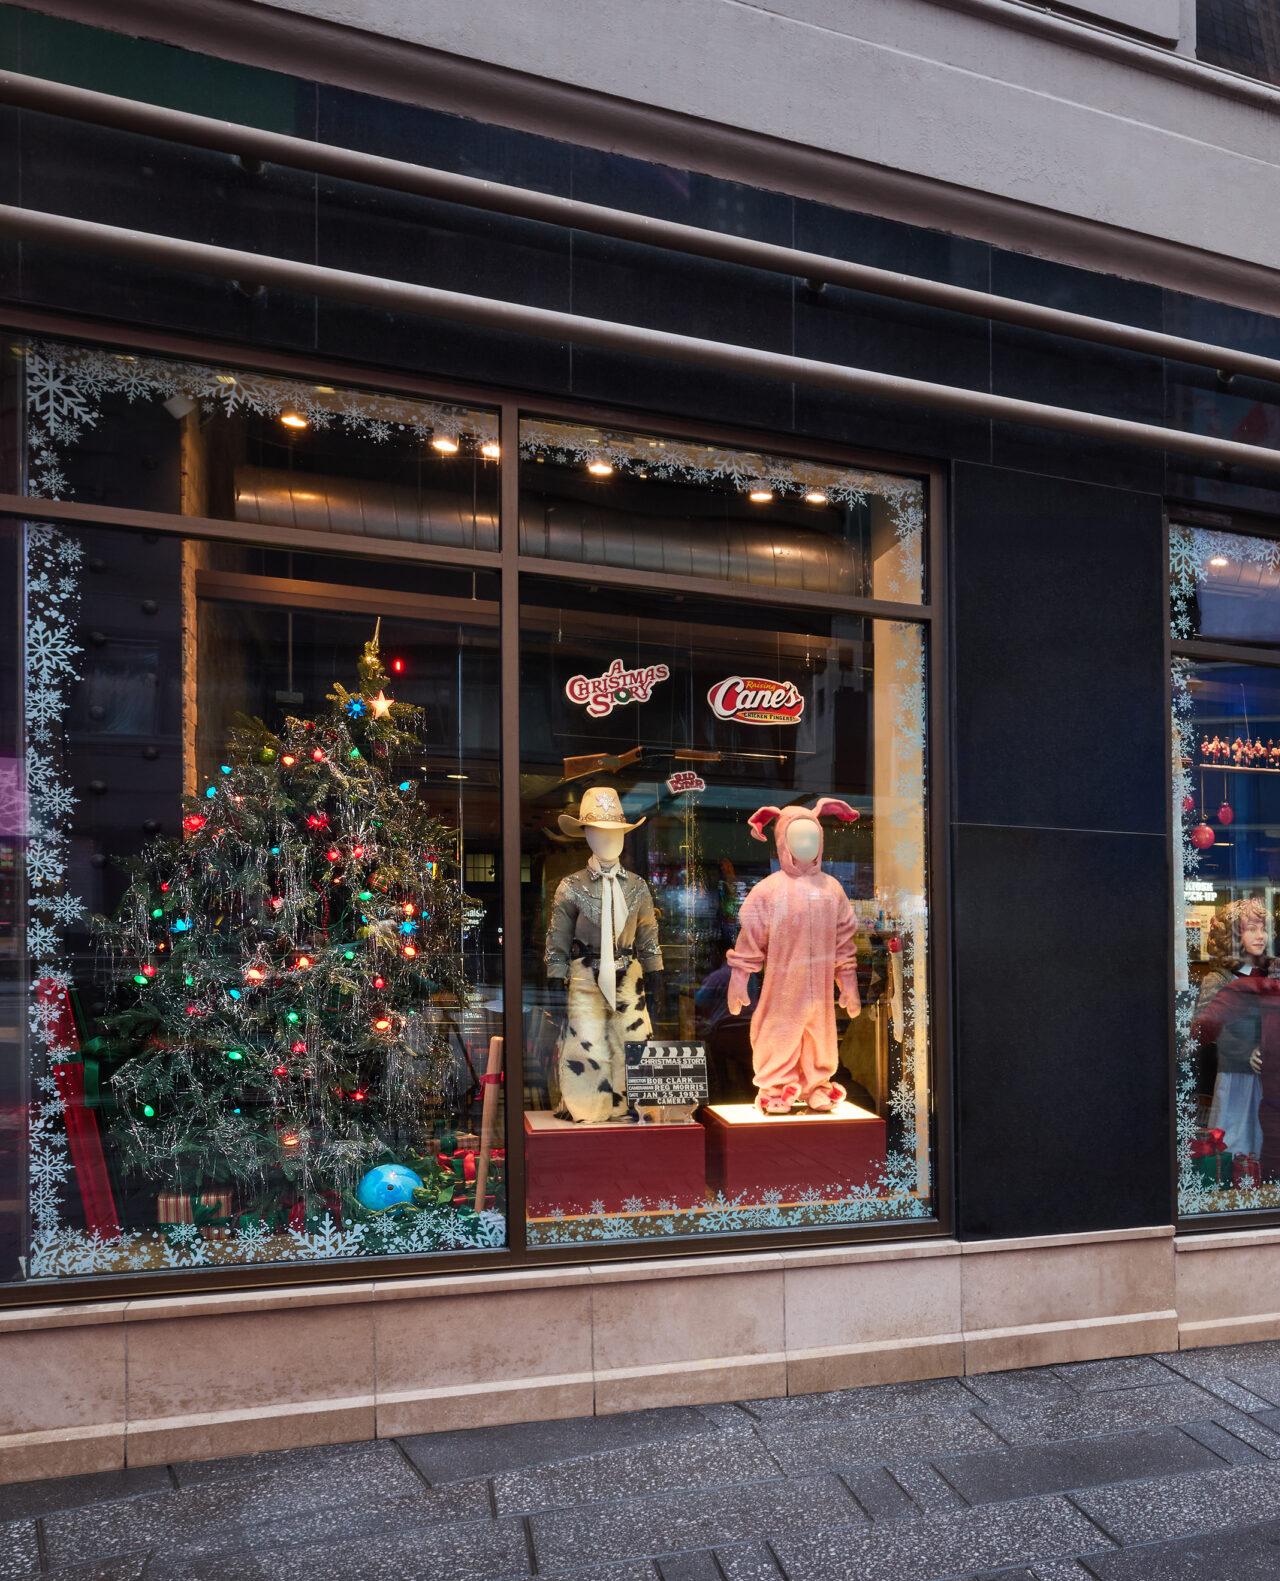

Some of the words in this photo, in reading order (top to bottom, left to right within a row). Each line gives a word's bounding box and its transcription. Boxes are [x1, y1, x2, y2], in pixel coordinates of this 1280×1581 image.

[606, 660, 623, 677] A
[568, 665, 669, 702] CHRISTMAS
[745, 680, 777, 692] Raising
[589, 681, 653, 715] STORY
[714, 676, 802, 717] Cane's
[657, 1097, 687, 1105] CAMERA
